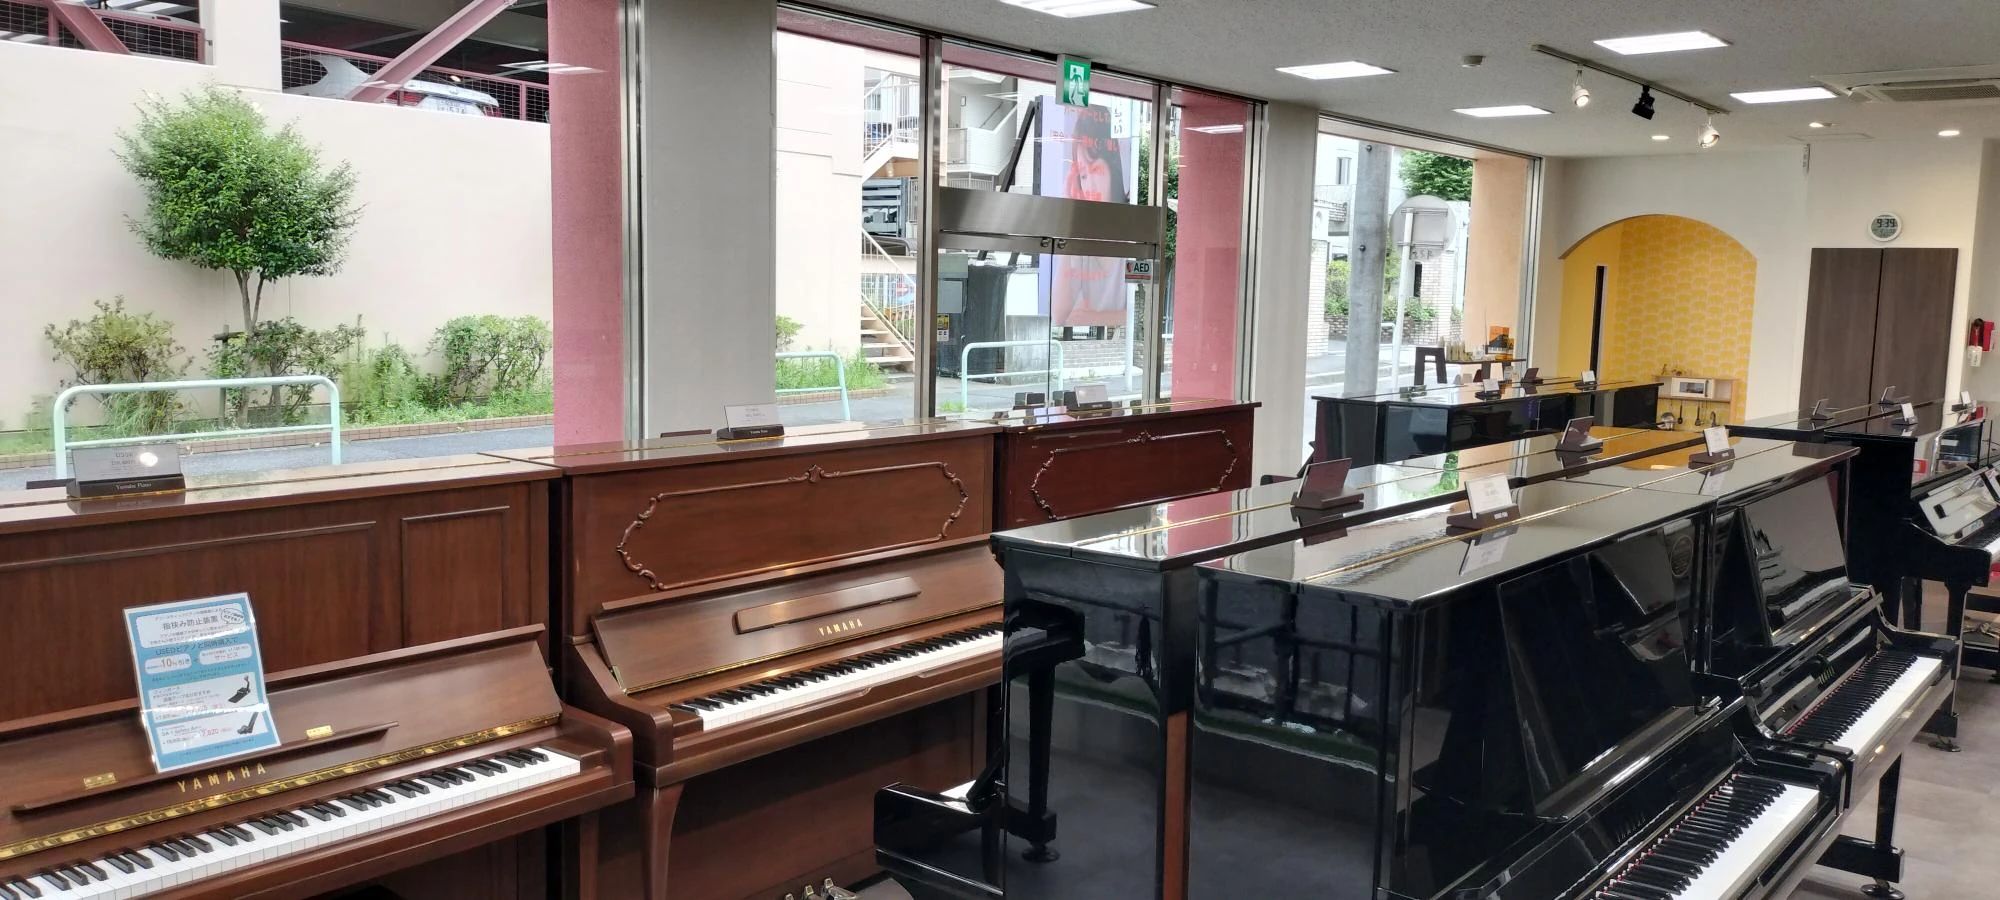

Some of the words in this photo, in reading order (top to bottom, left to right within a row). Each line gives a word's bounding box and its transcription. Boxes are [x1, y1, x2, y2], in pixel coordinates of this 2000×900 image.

[1133, 262, 1150, 273] AED
[819, 618, 863, 636] YAMAHA
[177, 763, 266, 793] YAMAHA
